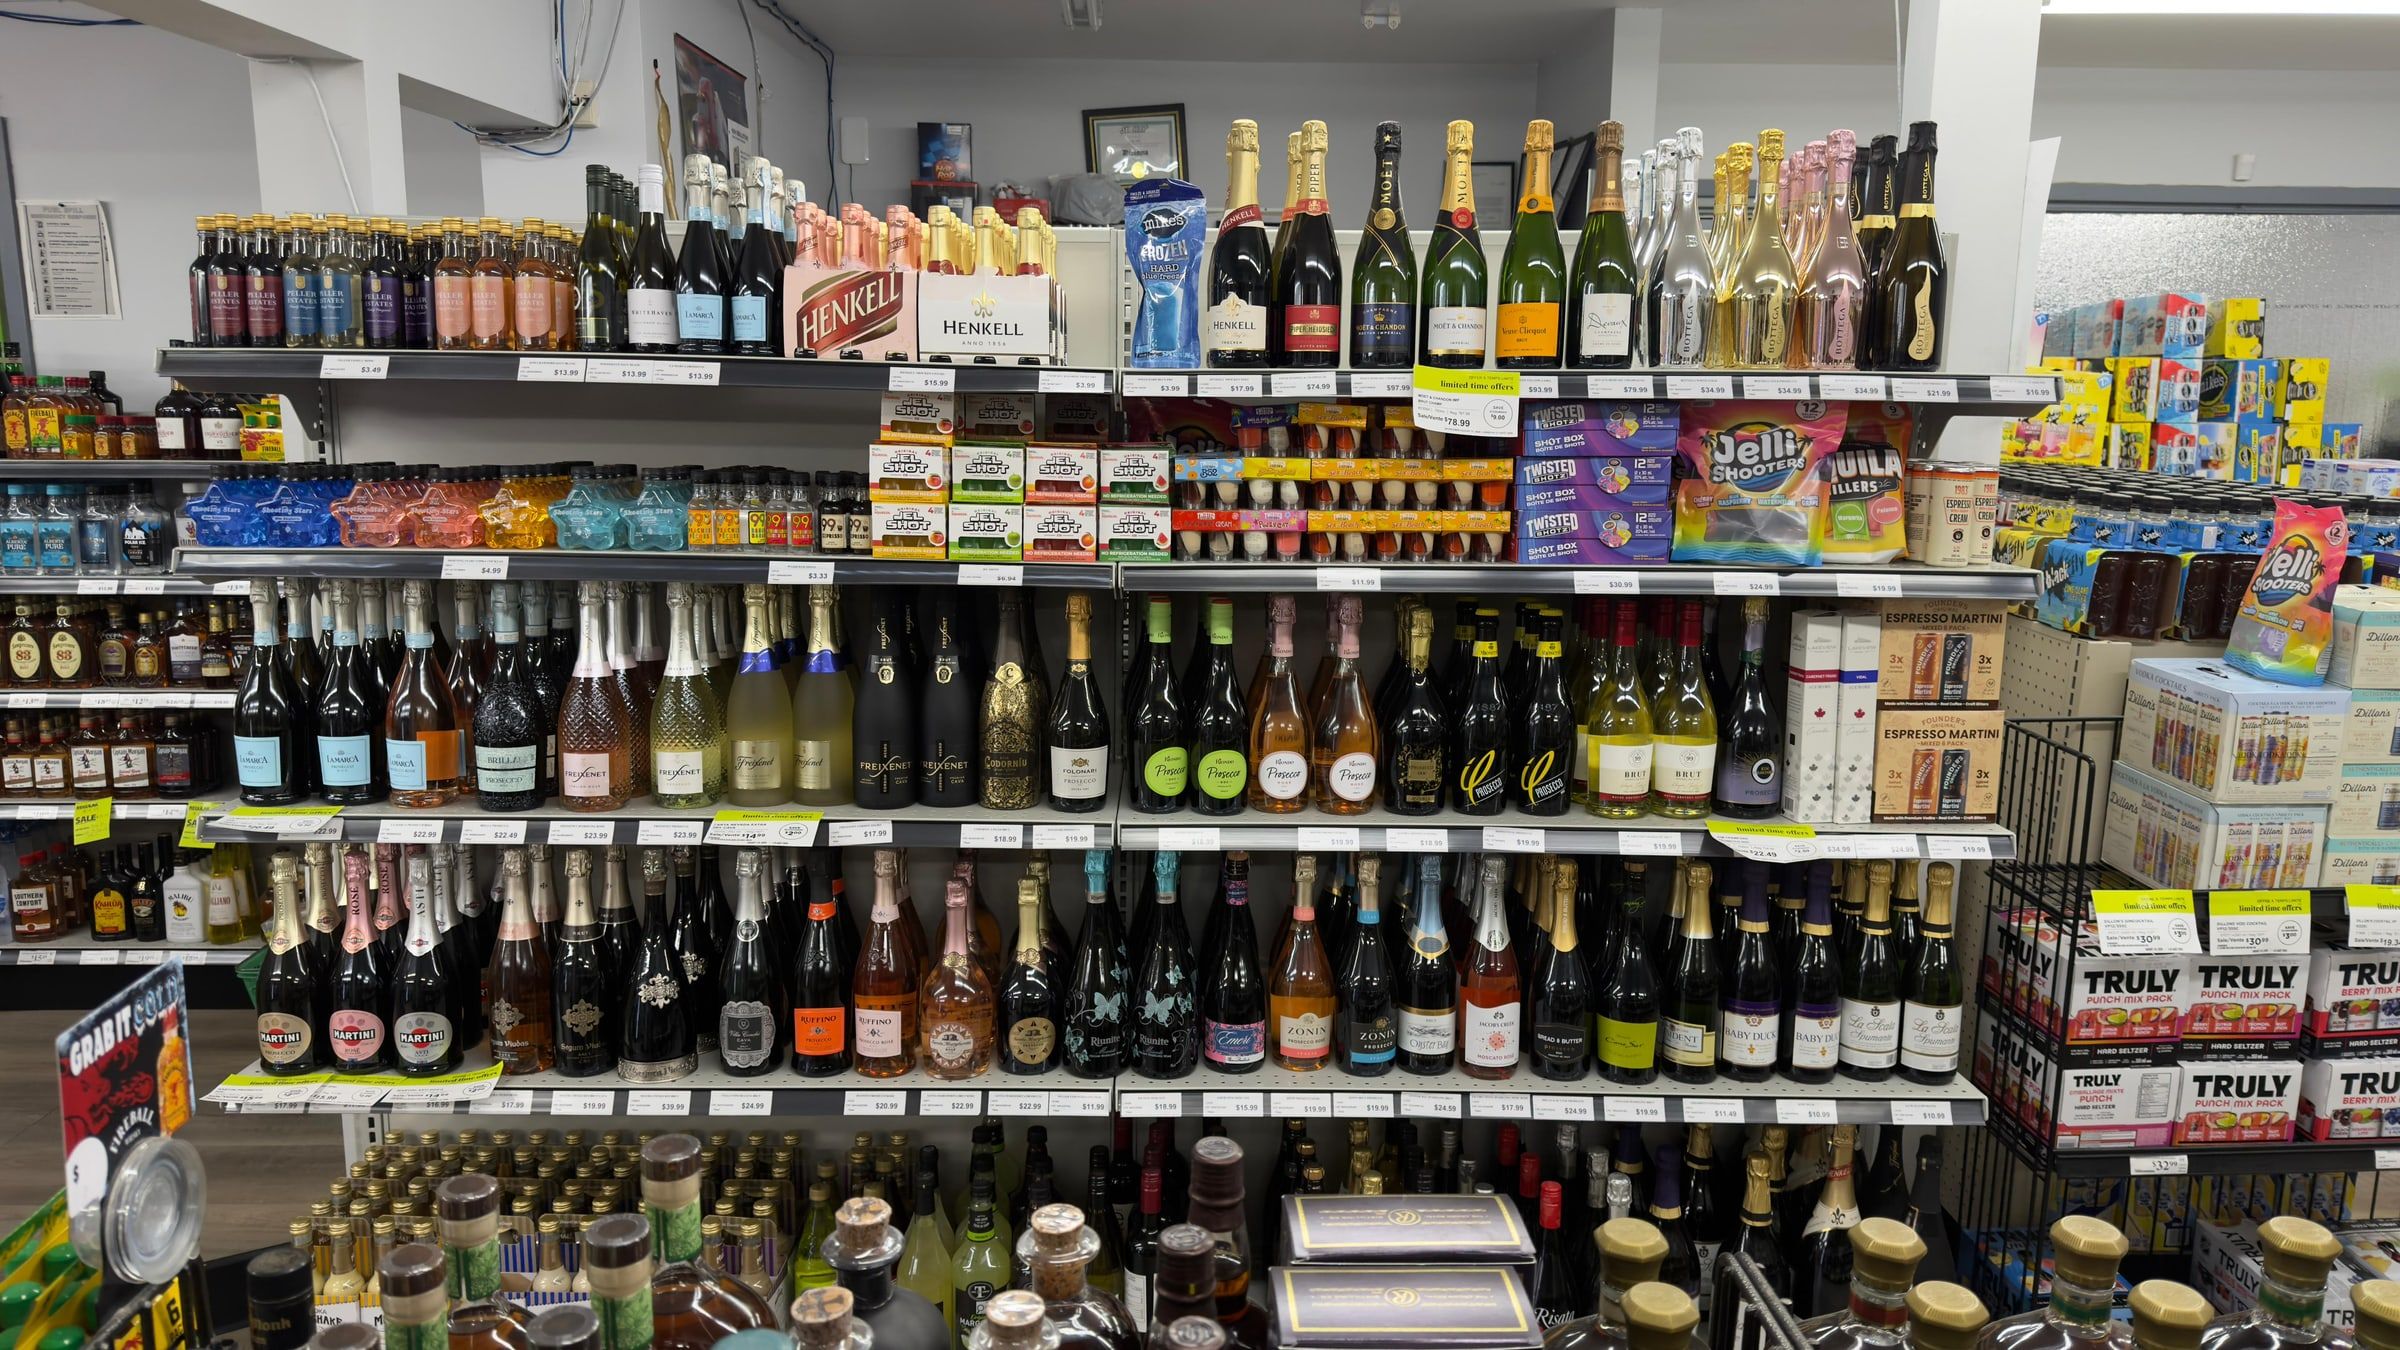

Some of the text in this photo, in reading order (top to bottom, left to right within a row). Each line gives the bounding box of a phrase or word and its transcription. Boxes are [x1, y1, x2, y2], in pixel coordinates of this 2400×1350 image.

[1310, 163, 1319, 192] PIPER
[1141, 241, 1188, 262] FROZEN
[1150, 264, 1179, 272] HARD
[288, 291, 317, 299] PELLER
[801, 271, 901, 349] HENKELL
[943, 320, 1023, 336] HENKELL
[1213, 321, 1256, 330] HENKELL
[1768, 306, 1781, 354] BOTTEGA
[1836, 306, 1847, 355] BOTTEGA
[1916, 304, 1928, 355] BOTTEGA
[1524, 327, 1547, 336] Clicquot
[622, 370, 646, 378] $13.99
[689, 372, 712, 380] $13.99
[1161, 384, 1180, 392] $3.99
[1307, 383, 1331, 391] $74.99
[1386, 384, 1410, 392] $97.99
[1440, 381, 1514, 391] limited time offers
[1623, 386, 1648, 394] $79.99
[1701, 386, 1725, 394] $34.99
[1778, 387, 1802, 395] $34.99
[1854, 387, 1878, 395] $34.99
[1927, 390, 1951, 398] $21.99
[1802, 402, 1819, 414] 12
[1445, 418, 1470, 427] $78.99
[1535, 433, 1584, 448] SHOT BOX
[1714, 430, 1798, 465] Jelli
[890, 453, 921, 463] JEL
[972, 454, 1002, 464] JEL
[1046, 456, 1076, 466] JEL
[1120, 457, 1150, 467] JEL
[884, 462, 928, 472] SHOT
[966, 463, 1010, 474] SHOT
[1635, 459, 1646, 468] 12
[1039, 464, 1084, 475] SHOT
[1113, 466, 1158, 476] SHOT
[1712, 457, 1804, 483] SHOOTERS
[1526, 488, 1576, 502] SHOT BOX
[750, 516, 764, 526] 99
[792, 516, 809, 526] 99
[893, 511, 923, 521] JEL
[1636, 513, 1647, 522] 12
[822, 518, 835, 530] 99
[886, 520, 931, 530] SHOT
[1528, 541, 1577, 556] SHOT BOX
[2252, 576, 2312, 594] SHOOTERS
[1886, 614, 2002, 624] ESPRESSO MARTINI
[16, 650, 31, 661] 83
[56, 650, 74, 661] 83
[1890, 655, 1903, 664] 3x
[1979, 655, 1992, 664] 3x
[2354, 708, 2391, 718] Dillon's
[1885, 729, 2000, 739] ESPRESSO MARTINI
[1207, 767, 1240, 779] Prosecco
[1267, 767, 1301, 779] Prosecco
[1339, 768, 1371, 781] Prosecco
[1888, 770, 1901, 780] 3x
[1535, 778, 1564, 798] PROSECCO
[2341, 784, 2377, 794] Dillon's
[75, 814, 96, 824] SALE
[413, 831, 437, 839] $22.99
[673, 831, 697, 839] $23.99
[2123, 903, 2149, 911] limited
[2169, 902, 2187, 911] offers
[2239, 904, 2302, 912] limited time offers
[2084, 969, 2180, 995] TRULY
[2200, 966, 2299, 990] TRULY
[2201, 990, 2291, 999] PUNCH MIX PACK
[2341, 987, 2393, 997] BERRY MIX
[2087, 995, 2173, 1004] PUNCH MIX PACK
[801, 1015, 837, 1024] RUFFINO
[859, 1017, 892, 1025] RUFFINO
[334, 1030, 375, 1039] MARTINI
[1288, 1025, 1326, 1036] ZONIN
[1360, 1029, 1395, 1041] ZONIN
[1726, 1029, 1749, 1040] BABY
[260, 1033, 300, 1042] MARTINI
[400, 1032, 444, 1042] MARTINI
[1796, 1031, 1823, 1044] BABY
[2370, 1038, 2398, 1047] SELTZER
[2193, 1074, 2291, 1099] TRULY
[2195, 1099, 2283, 1108] PUNCH MIX PACK
[2343, 1096, 2396, 1105] BERRY MIX
[110, 1106, 155, 1155] FIREBALL
[1535, 1308, 1575, 1327] Risata
